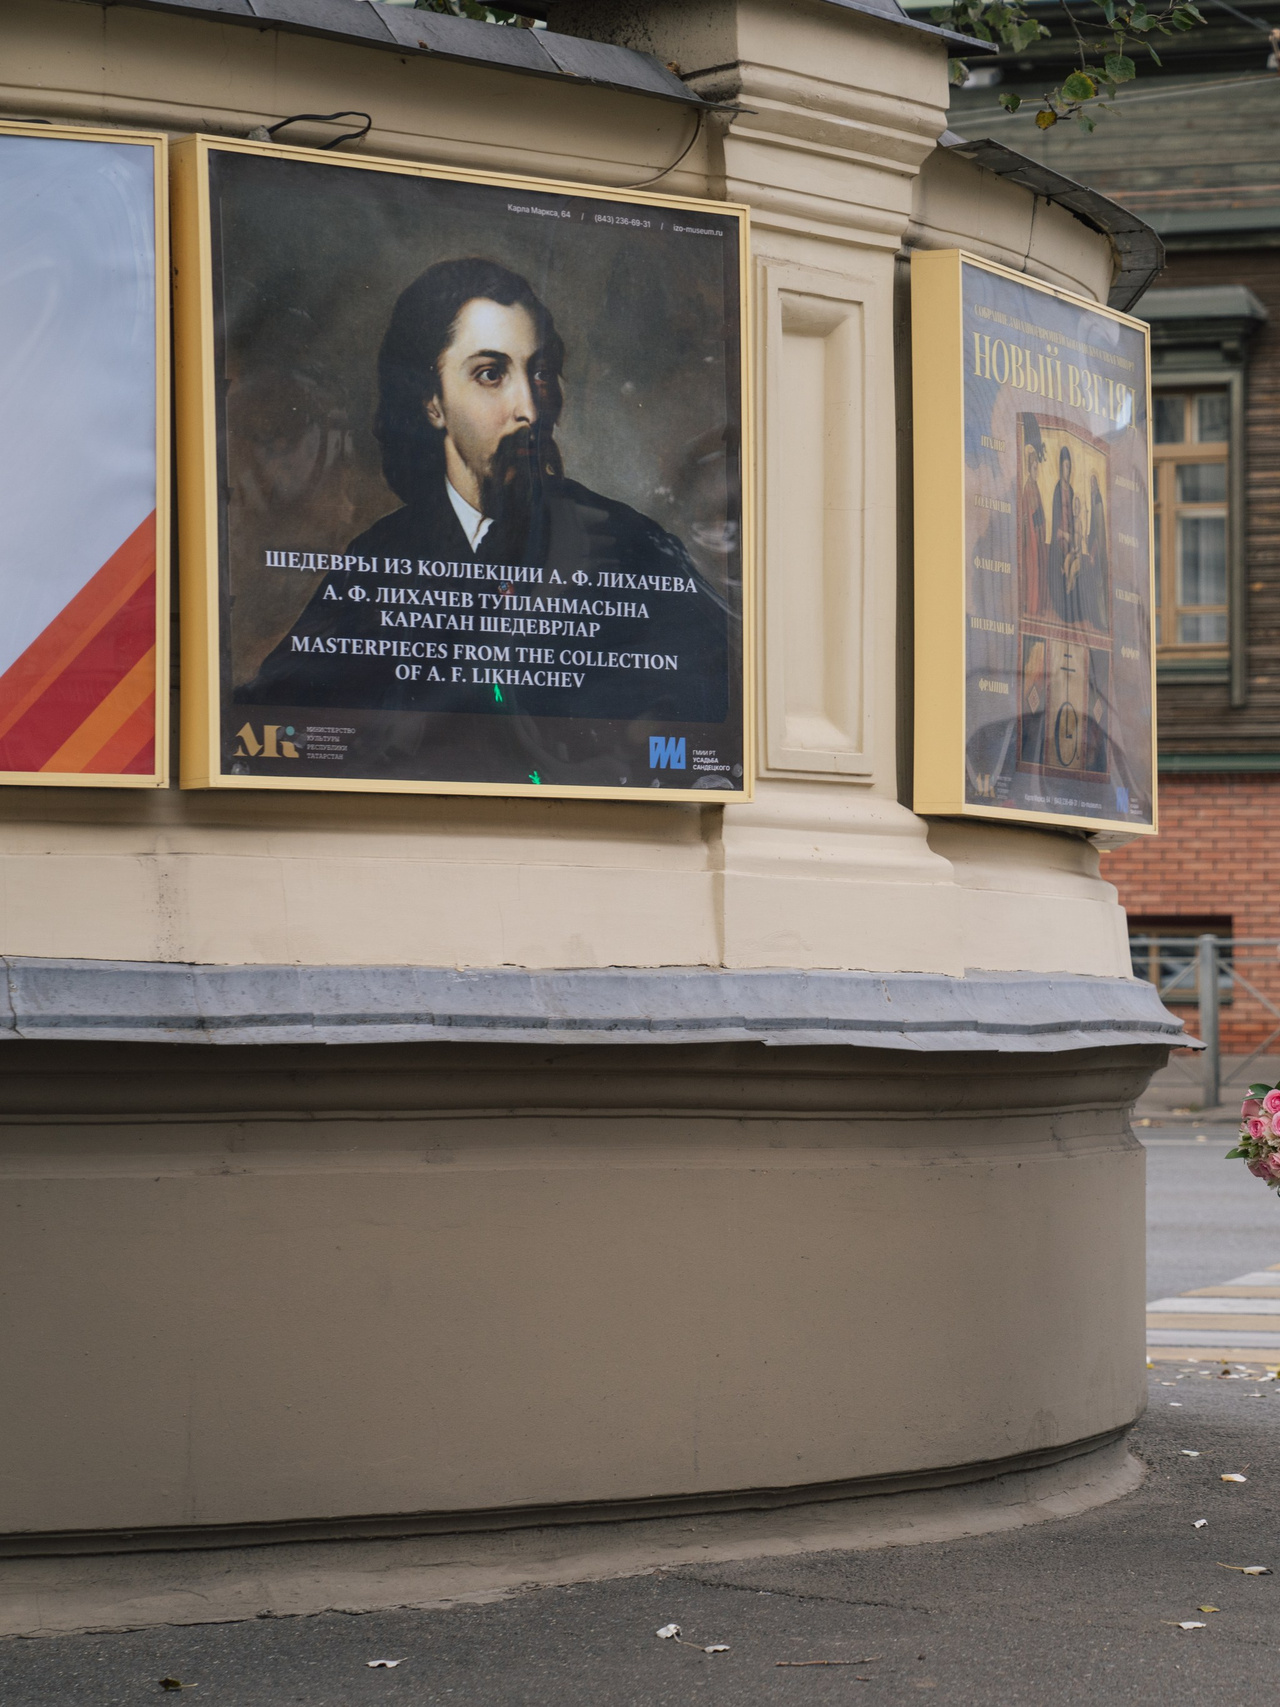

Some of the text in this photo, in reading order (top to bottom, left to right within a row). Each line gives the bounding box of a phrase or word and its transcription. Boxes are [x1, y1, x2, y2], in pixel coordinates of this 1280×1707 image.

[507, 203, 530, 214] Карла
[531, 206, 560, 218] Маркса,
[561, 210, 571, 219] 64
[594, 214, 615, 225] (843)
[615, 216, 651, 228] 236-69-31
[673, 223, 723, 237] izo-museum.ru
[972, 331, 1138, 438] НОВЫЙ ВЗГЛЯД
[265, 550, 698, 594] ШЕДЕВРЫ ИЗ КОЛЛЕКЦИИ А. Ф. ЛИХАЧЕВА
[322, 584, 650, 619] А. Ф. ЛИХАЧЕВ ТУПЛАНМАСЫНА
[380, 610, 601, 638] КАРАГАН ШЕДЕВРЛАР
[291, 635, 679, 671] MASTERPIECES FROM THE COLLECTION
[395, 663, 586, 688] OF A. F. LIKHACHEV
